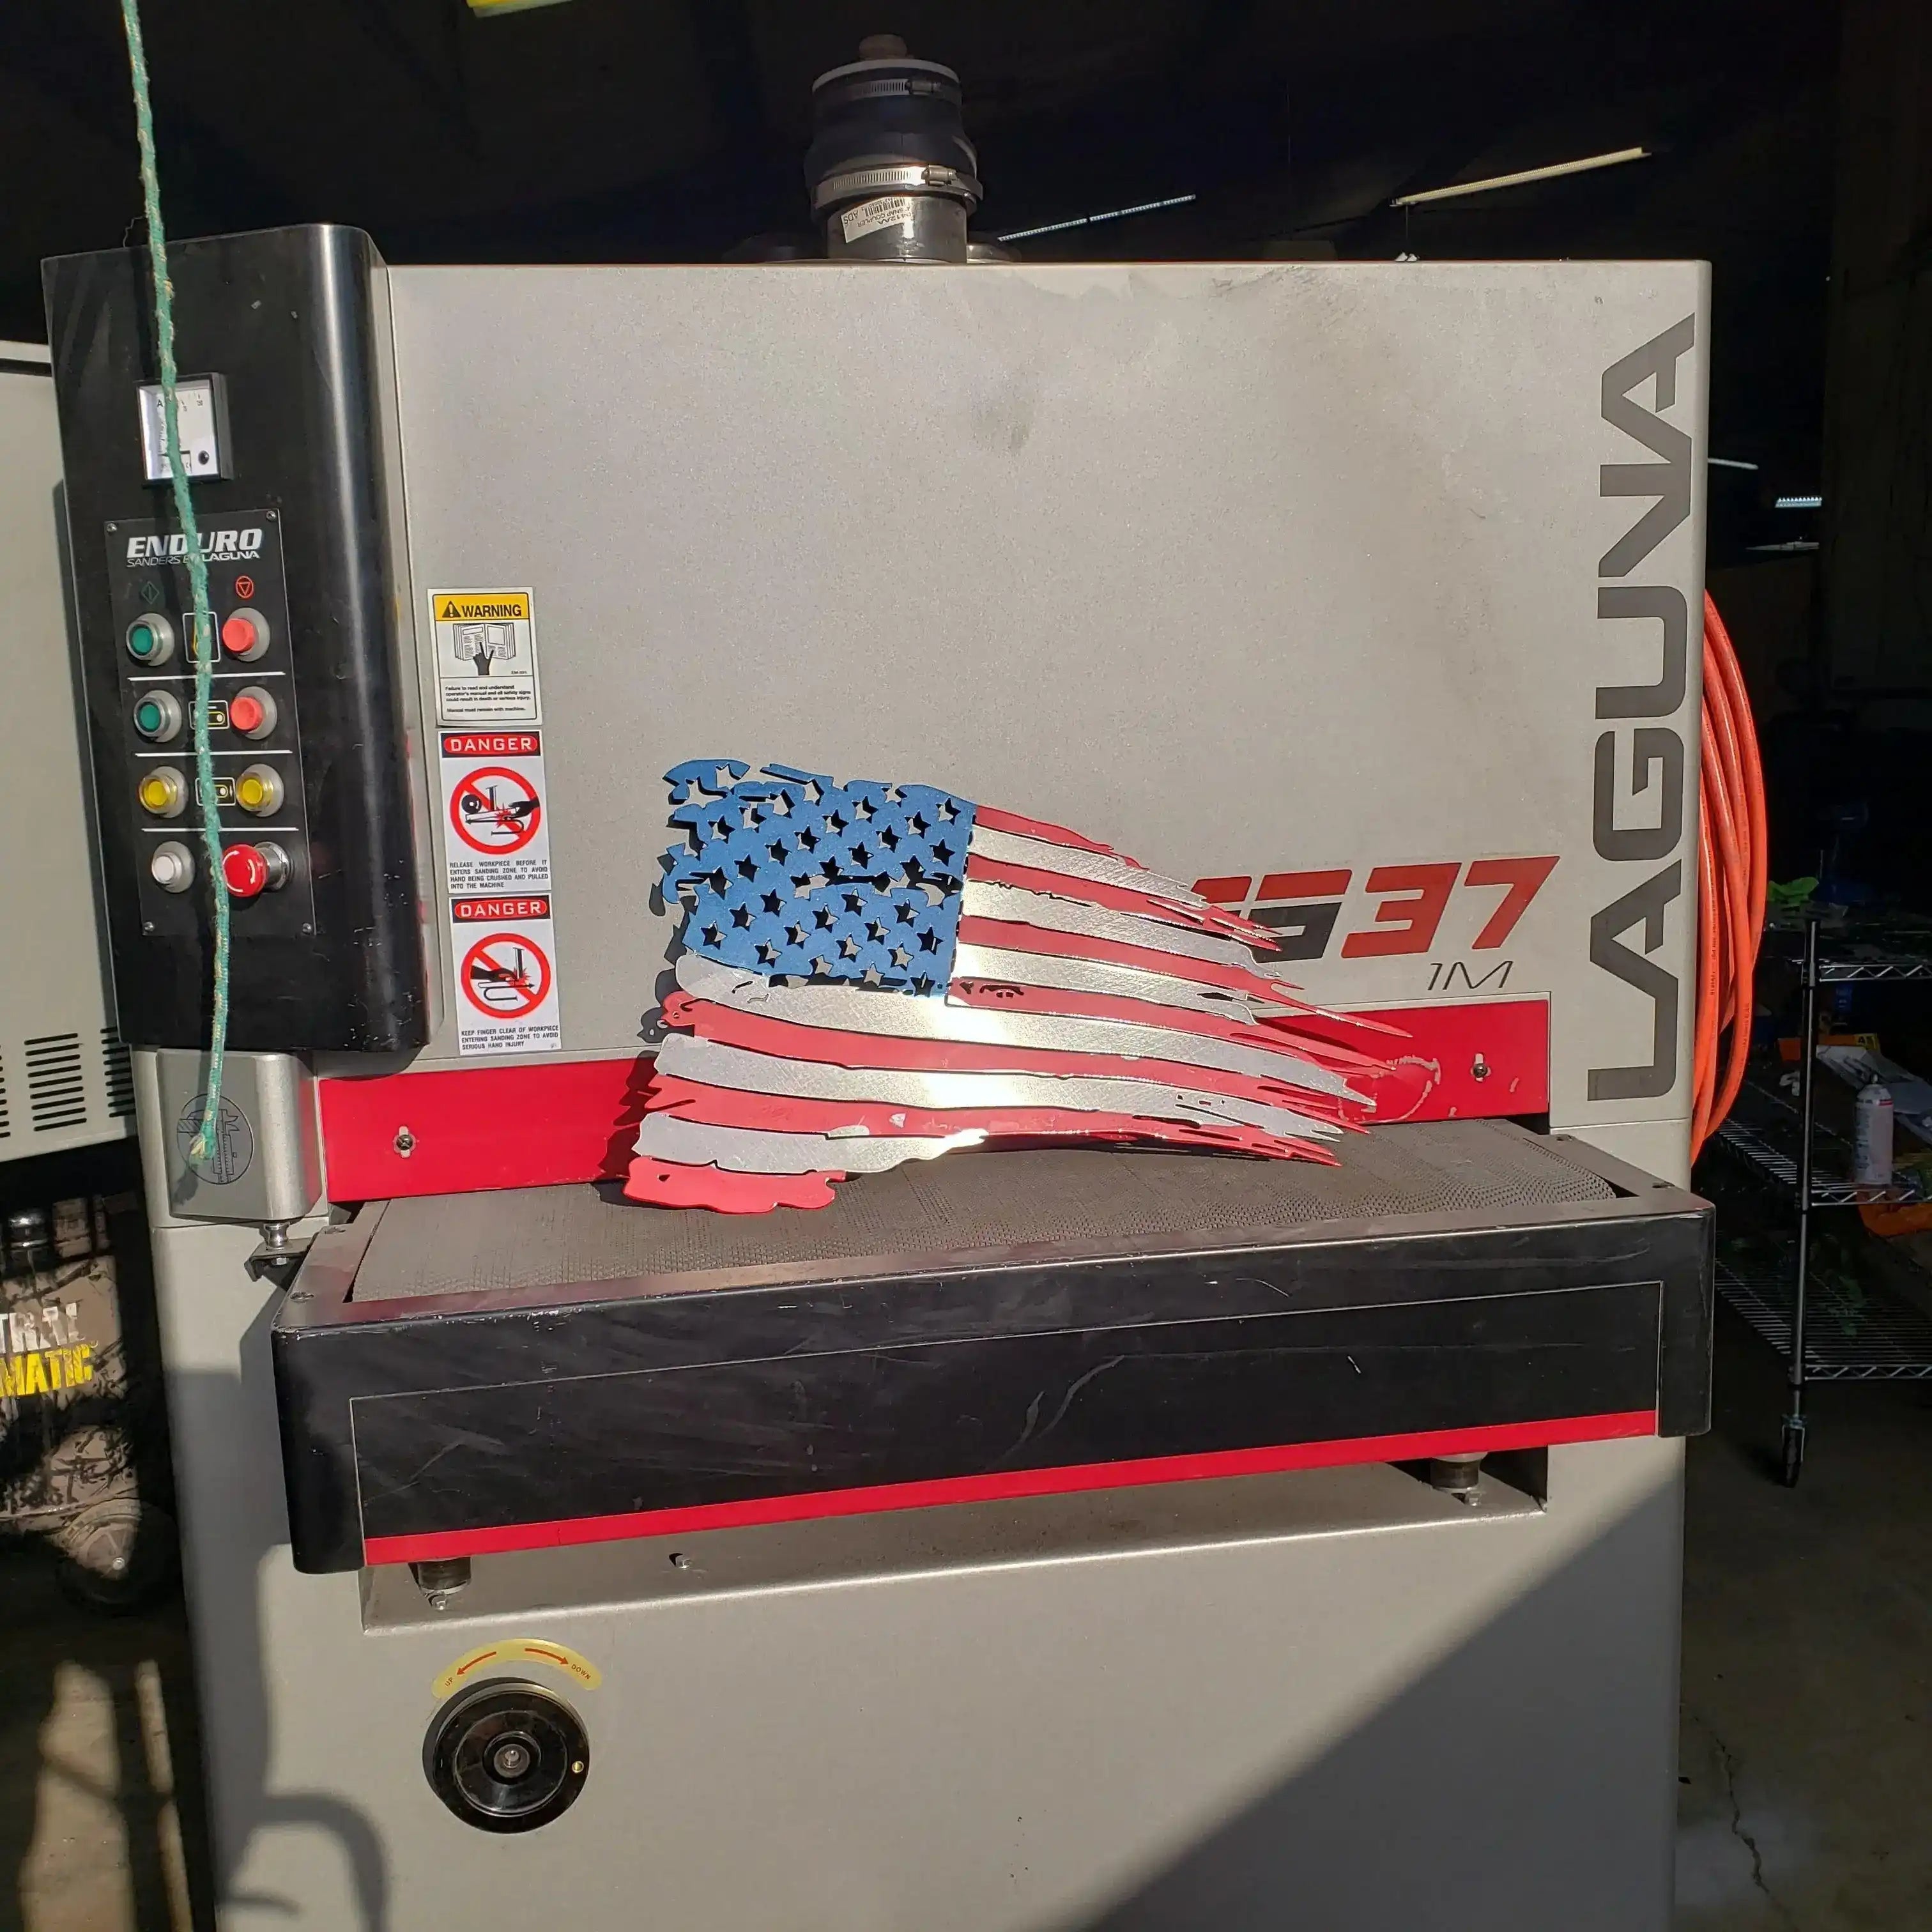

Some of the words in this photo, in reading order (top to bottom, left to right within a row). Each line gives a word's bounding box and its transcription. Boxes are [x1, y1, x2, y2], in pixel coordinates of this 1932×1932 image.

[843, 210, 859, 225] ADS
[857, 213, 886, 227] COUPLER
[126, 528, 263, 558] ENDURO
[126, 555, 181, 568] SANDERS
[202, 551, 261, 563] LAGUNA
[461, 604, 522, 618] WARNING
[1587, 312, 1695, 1101] LAGUNA
[450, 737, 532, 752] DANGER
[460, 902, 542, 917] DANGER
[1191, 855, 1560, 963] S37
[1427, 960, 1514, 991] 1M
[571, 1664, 591, 1680] DOWN
[445, 1676, 454, 1687] UP
